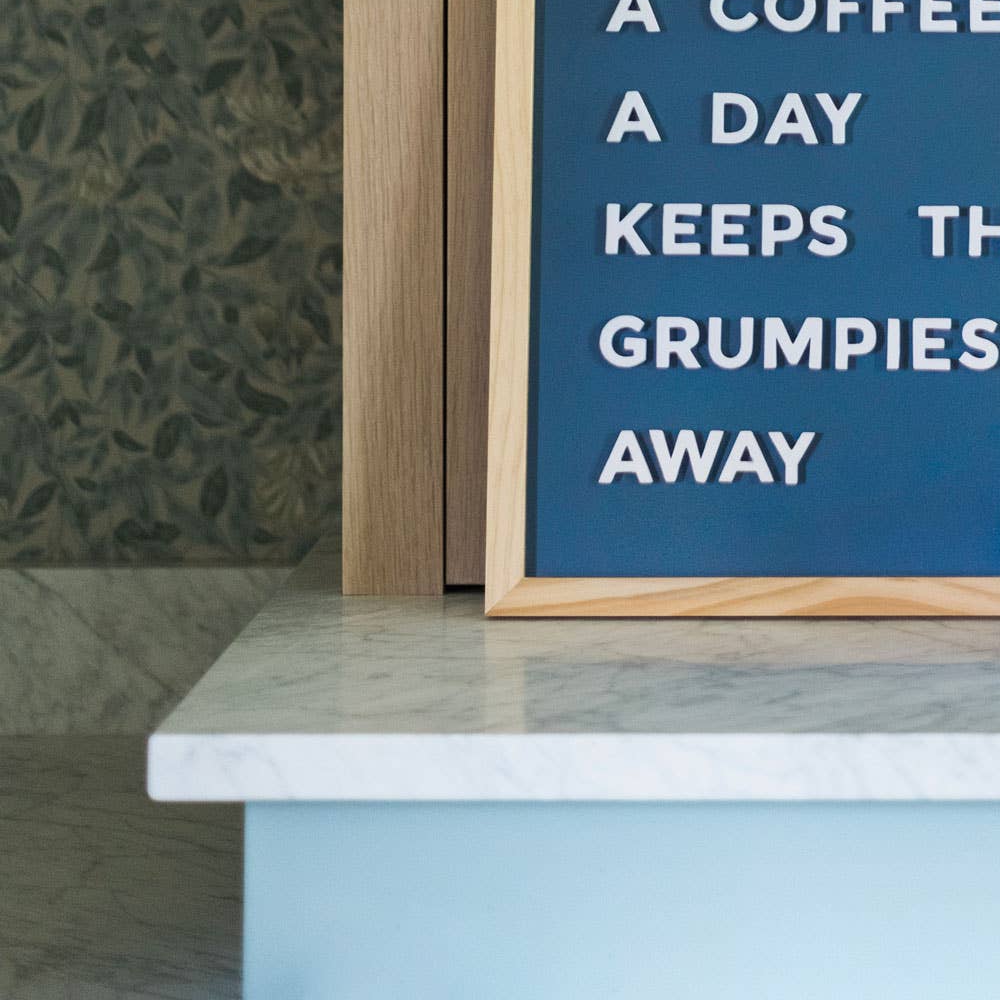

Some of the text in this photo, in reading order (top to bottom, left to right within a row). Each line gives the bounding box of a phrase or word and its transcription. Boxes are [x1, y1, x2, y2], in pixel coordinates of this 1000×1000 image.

[606, 90, 862, 145] A DAY
[604, 202, 848, 257] KEEPS
[599, 315, 999, 371] GRUMPIES
[598, 429, 815, 485] AWAY
